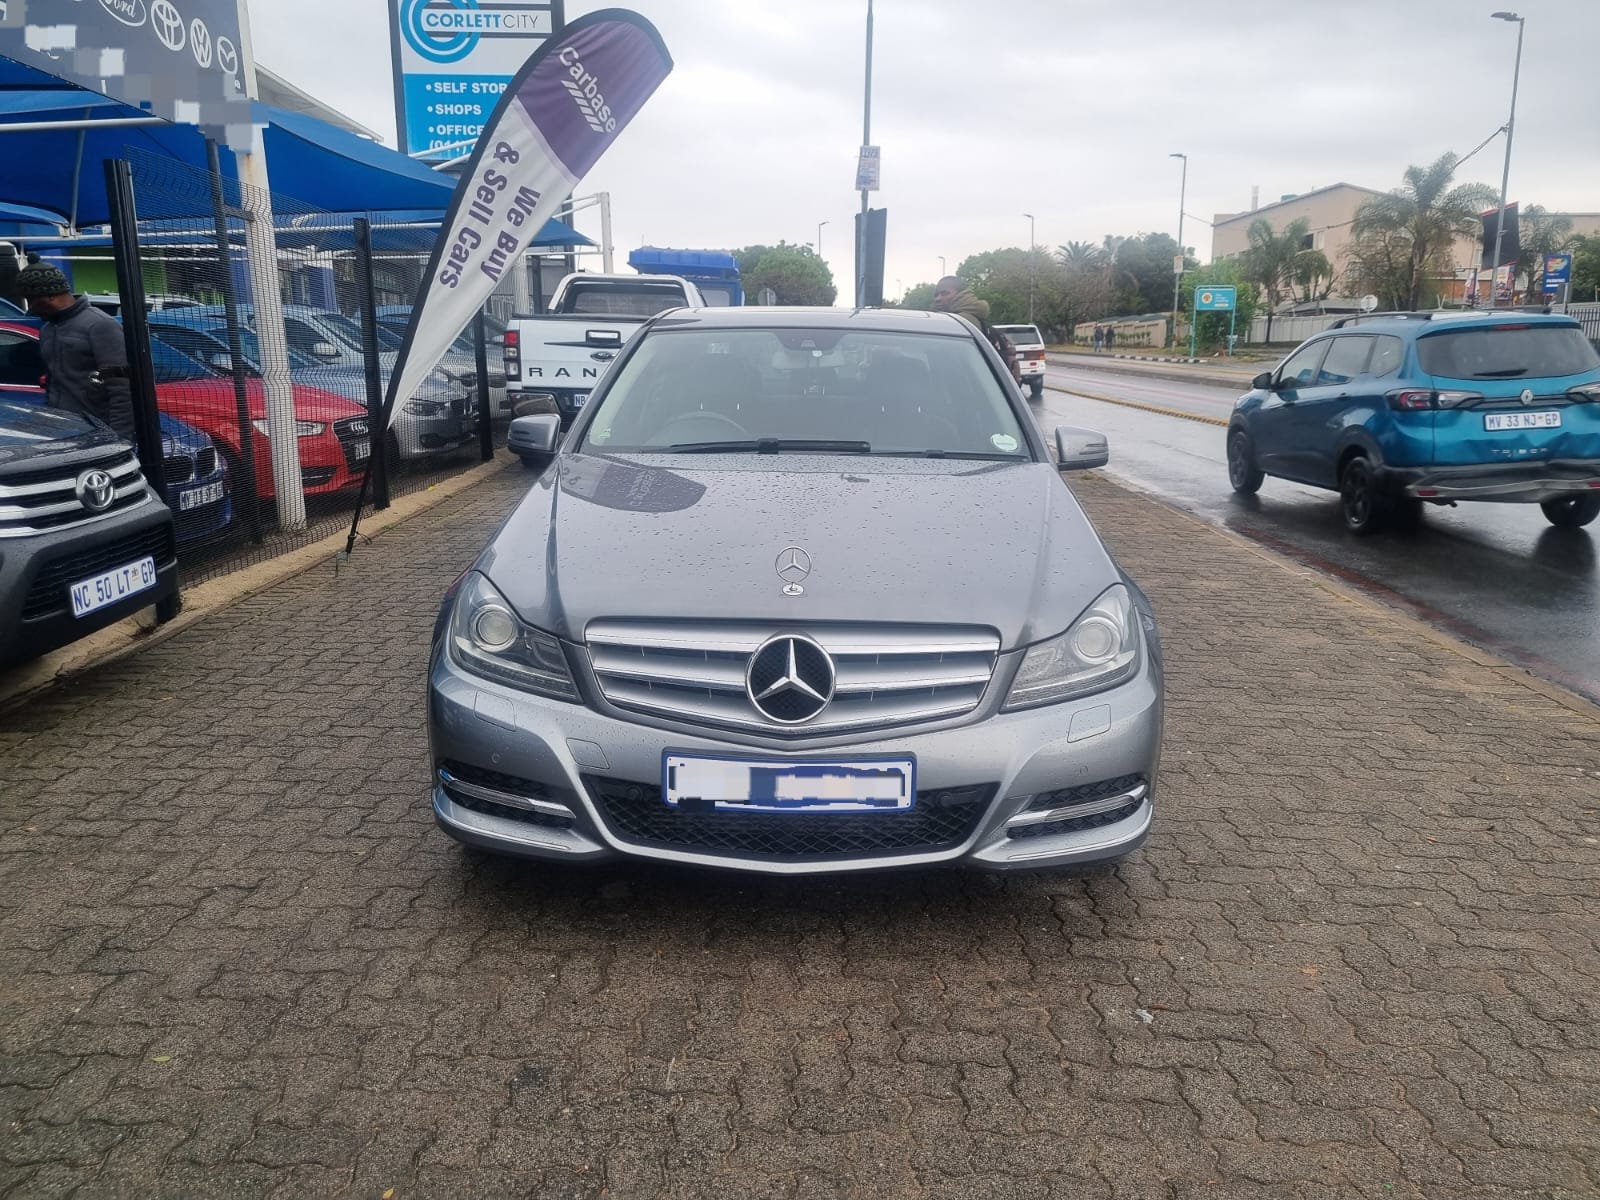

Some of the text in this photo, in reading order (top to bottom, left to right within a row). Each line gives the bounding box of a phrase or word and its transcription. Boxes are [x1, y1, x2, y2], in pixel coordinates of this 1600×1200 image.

[105, 0, 136, 18] ord
[434, 82, 467, 93] SELF
[560, 47, 616, 133] Carbase
[435, 104, 482, 115] SHOPS
[440, 141, 520, 288] & Sell Cars
[480, 185, 541, 282] We Buy
[1488, 413, 1558, 428] MV 33 NJ GP
[73, 560, 154, 612] NC 50 LT GP
